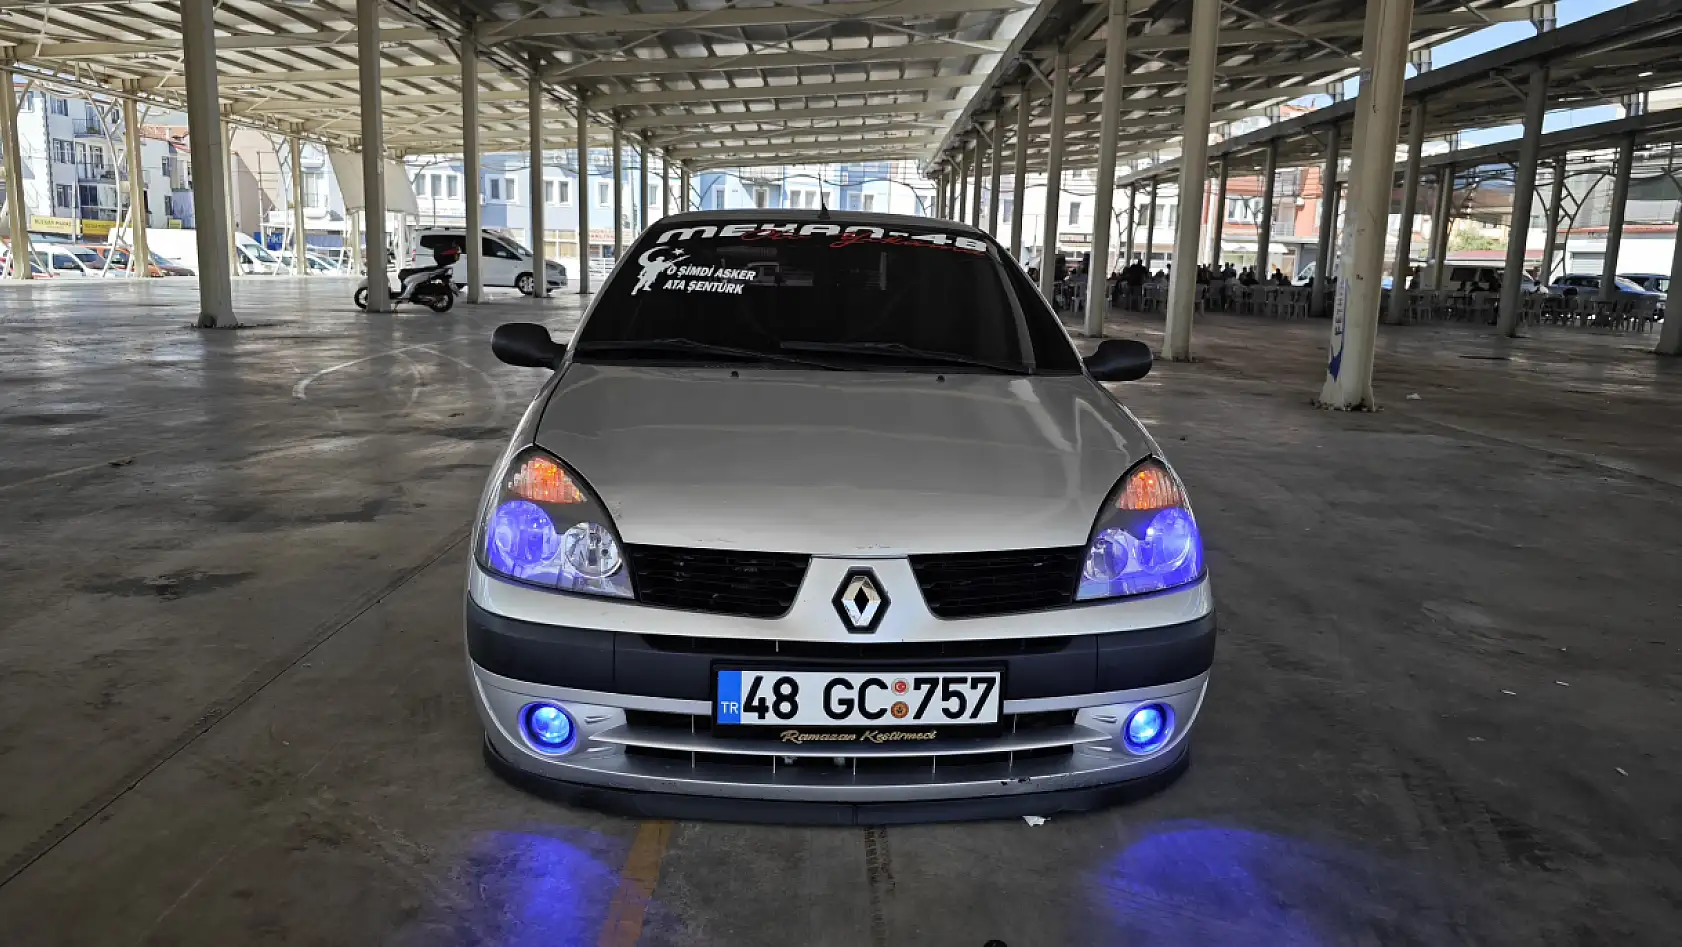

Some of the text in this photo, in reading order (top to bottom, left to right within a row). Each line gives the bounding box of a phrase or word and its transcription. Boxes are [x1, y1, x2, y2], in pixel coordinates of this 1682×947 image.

[666, 263, 757, 281] O ŞİMDİ ASKER
[663, 279, 745, 295] ATA ŞENTÜRK
[721, 675, 997, 720] TR 48 GC 757
[780, 729, 857, 744] Ramazan
